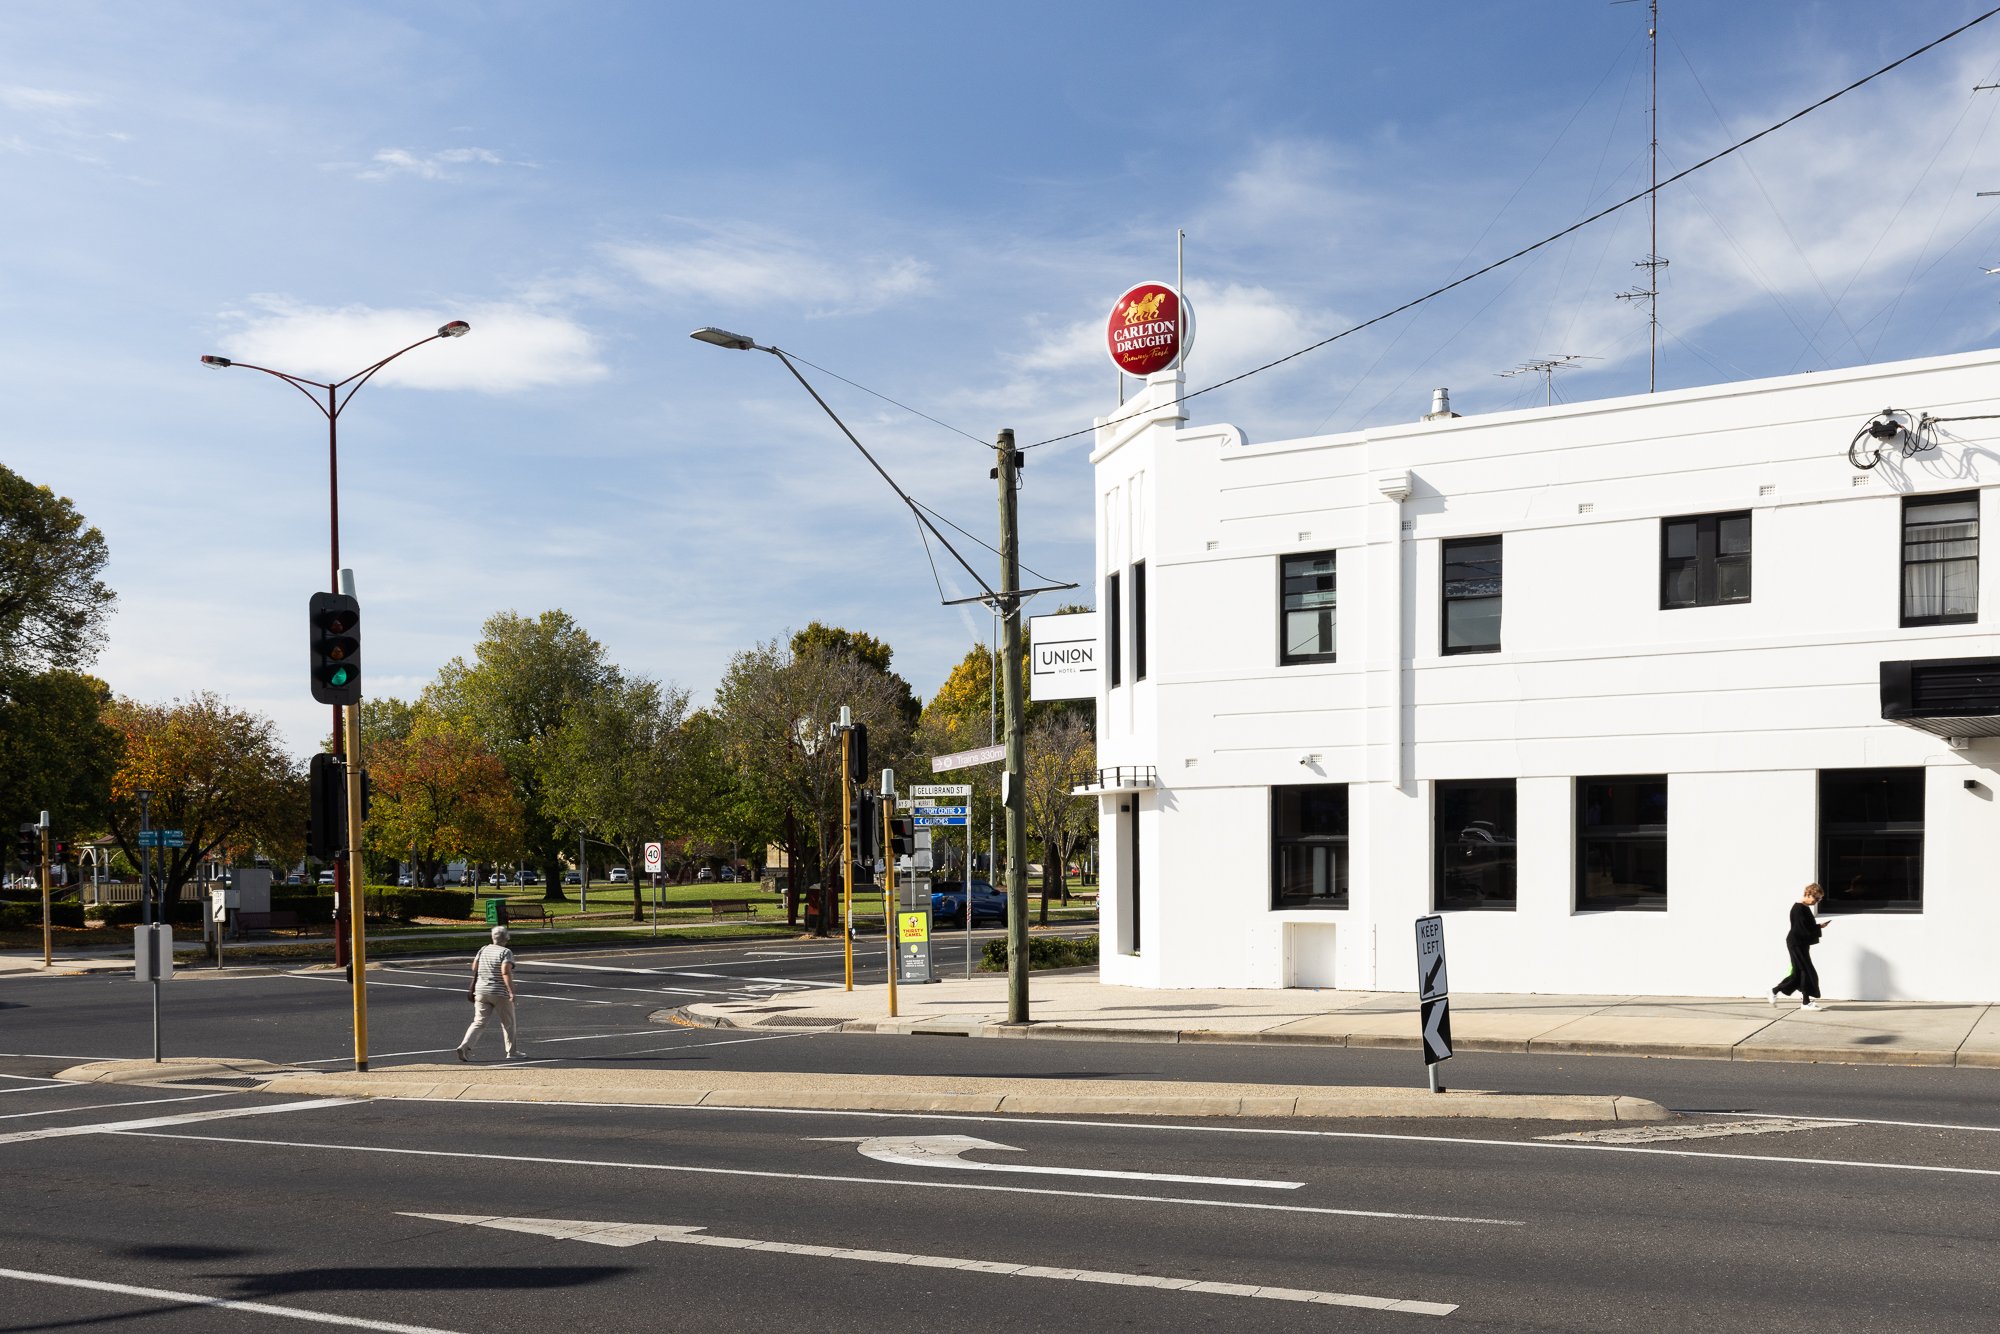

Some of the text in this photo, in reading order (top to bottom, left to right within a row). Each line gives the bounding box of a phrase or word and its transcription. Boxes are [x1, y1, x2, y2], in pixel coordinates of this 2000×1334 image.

[1114, 320, 1175, 342] CARLTON
[1117, 333, 1173, 353] DRAUGHT
[1043, 648, 1092, 665] UNION
[956, 749, 1003, 765] Trains 330m
[917, 786, 963, 795] GELLIBRAND ST
[918, 807, 956, 815] HISTORY CENTRE
[924, 817, 949, 825] CHURCHES
[648, 850, 658, 858] 40
[1421, 924, 1439, 938] KEEP
[1422, 940, 1439, 955] LEFT
